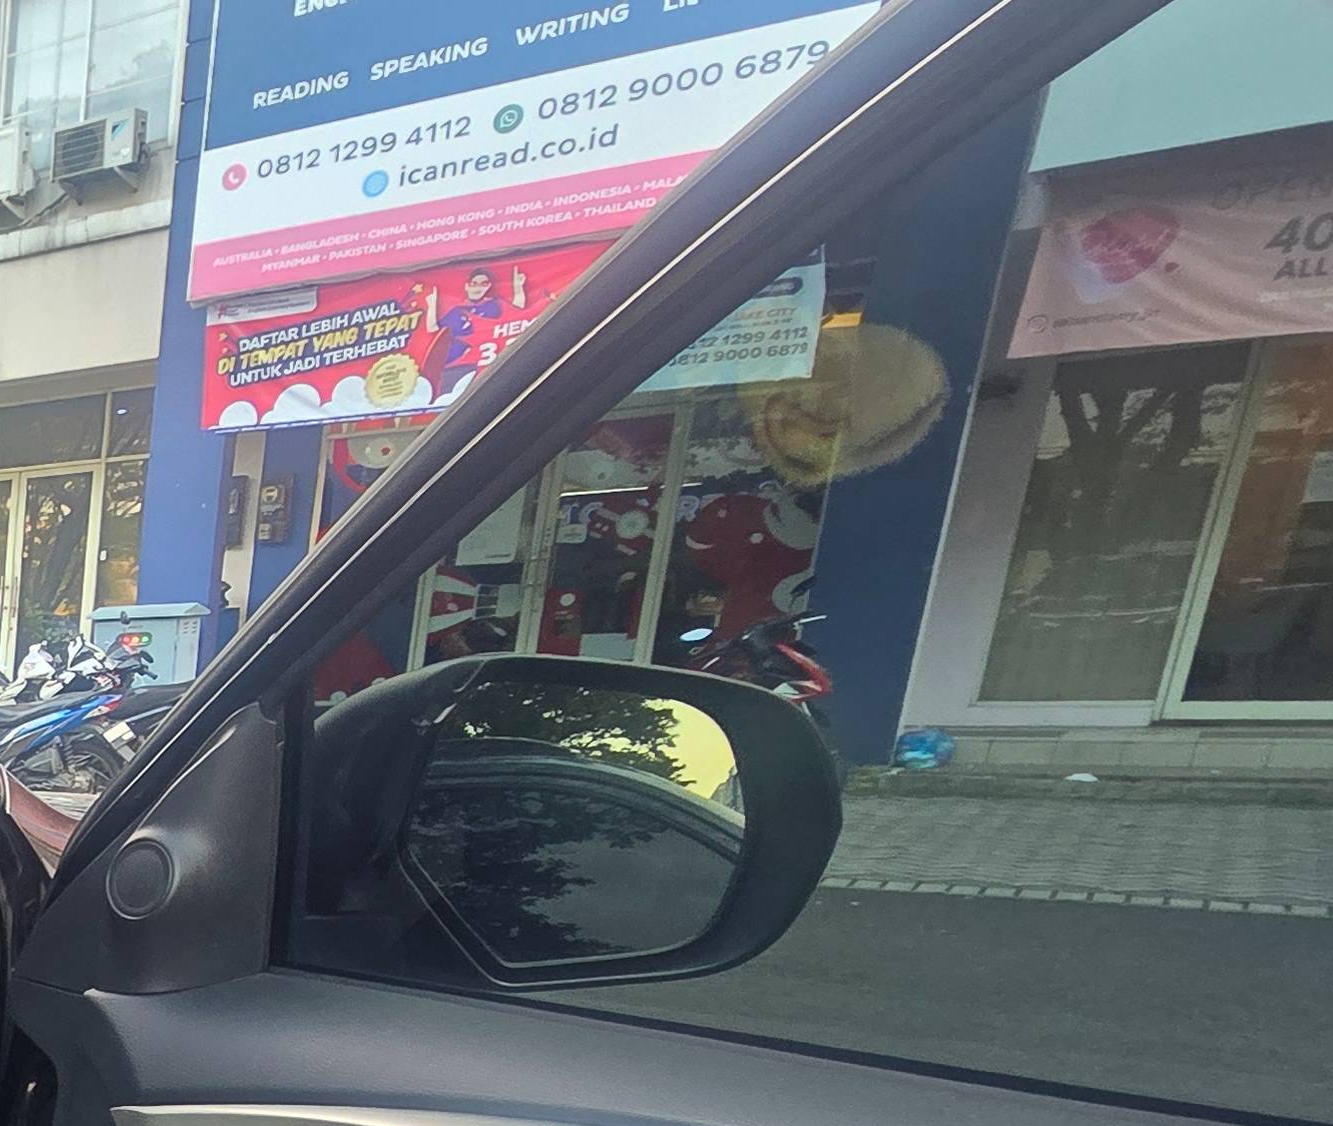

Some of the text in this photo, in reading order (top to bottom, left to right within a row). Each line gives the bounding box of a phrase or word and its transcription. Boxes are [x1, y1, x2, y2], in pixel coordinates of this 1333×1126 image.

[253, 3, 631, 110] READING SPEAKING WRITING
[256, 40, 831, 180] 0812 1299 4112 0812 9000 6879
[398, 123, 620, 188] icanread.co.id
[212, 248, 275, 268] AUSTRALIA
[281, 232, 361, 256] BANGLADESH
[367, 223, 408, 241] CHINA
[416, 214, 455, 232] HONG
[457, 208, 495, 225] KONG
[504, 199, 543, 216] INDIA
[552, 184, 632, 208] INDONESIA
[261, 197, 658, 274] MYANMAR PAKISTAN SINGAPORE SOUTH KOREA THAILAND
[1273, 256, 1328, 282] ALL
[217, 310, 424, 376] DI TEMPAT YANG TEPAT
[238, 302, 401, 353] DAFTAR LEBIH AWAL
[713, 346, 762, 363] 9000
[766, 342, 809, 358] 6879
[723, 331, 766, 346] 1299
[768, 326, 809, 342] 4112
[229, 334, 410, 387] UNTUK JADI TERHEBAT
